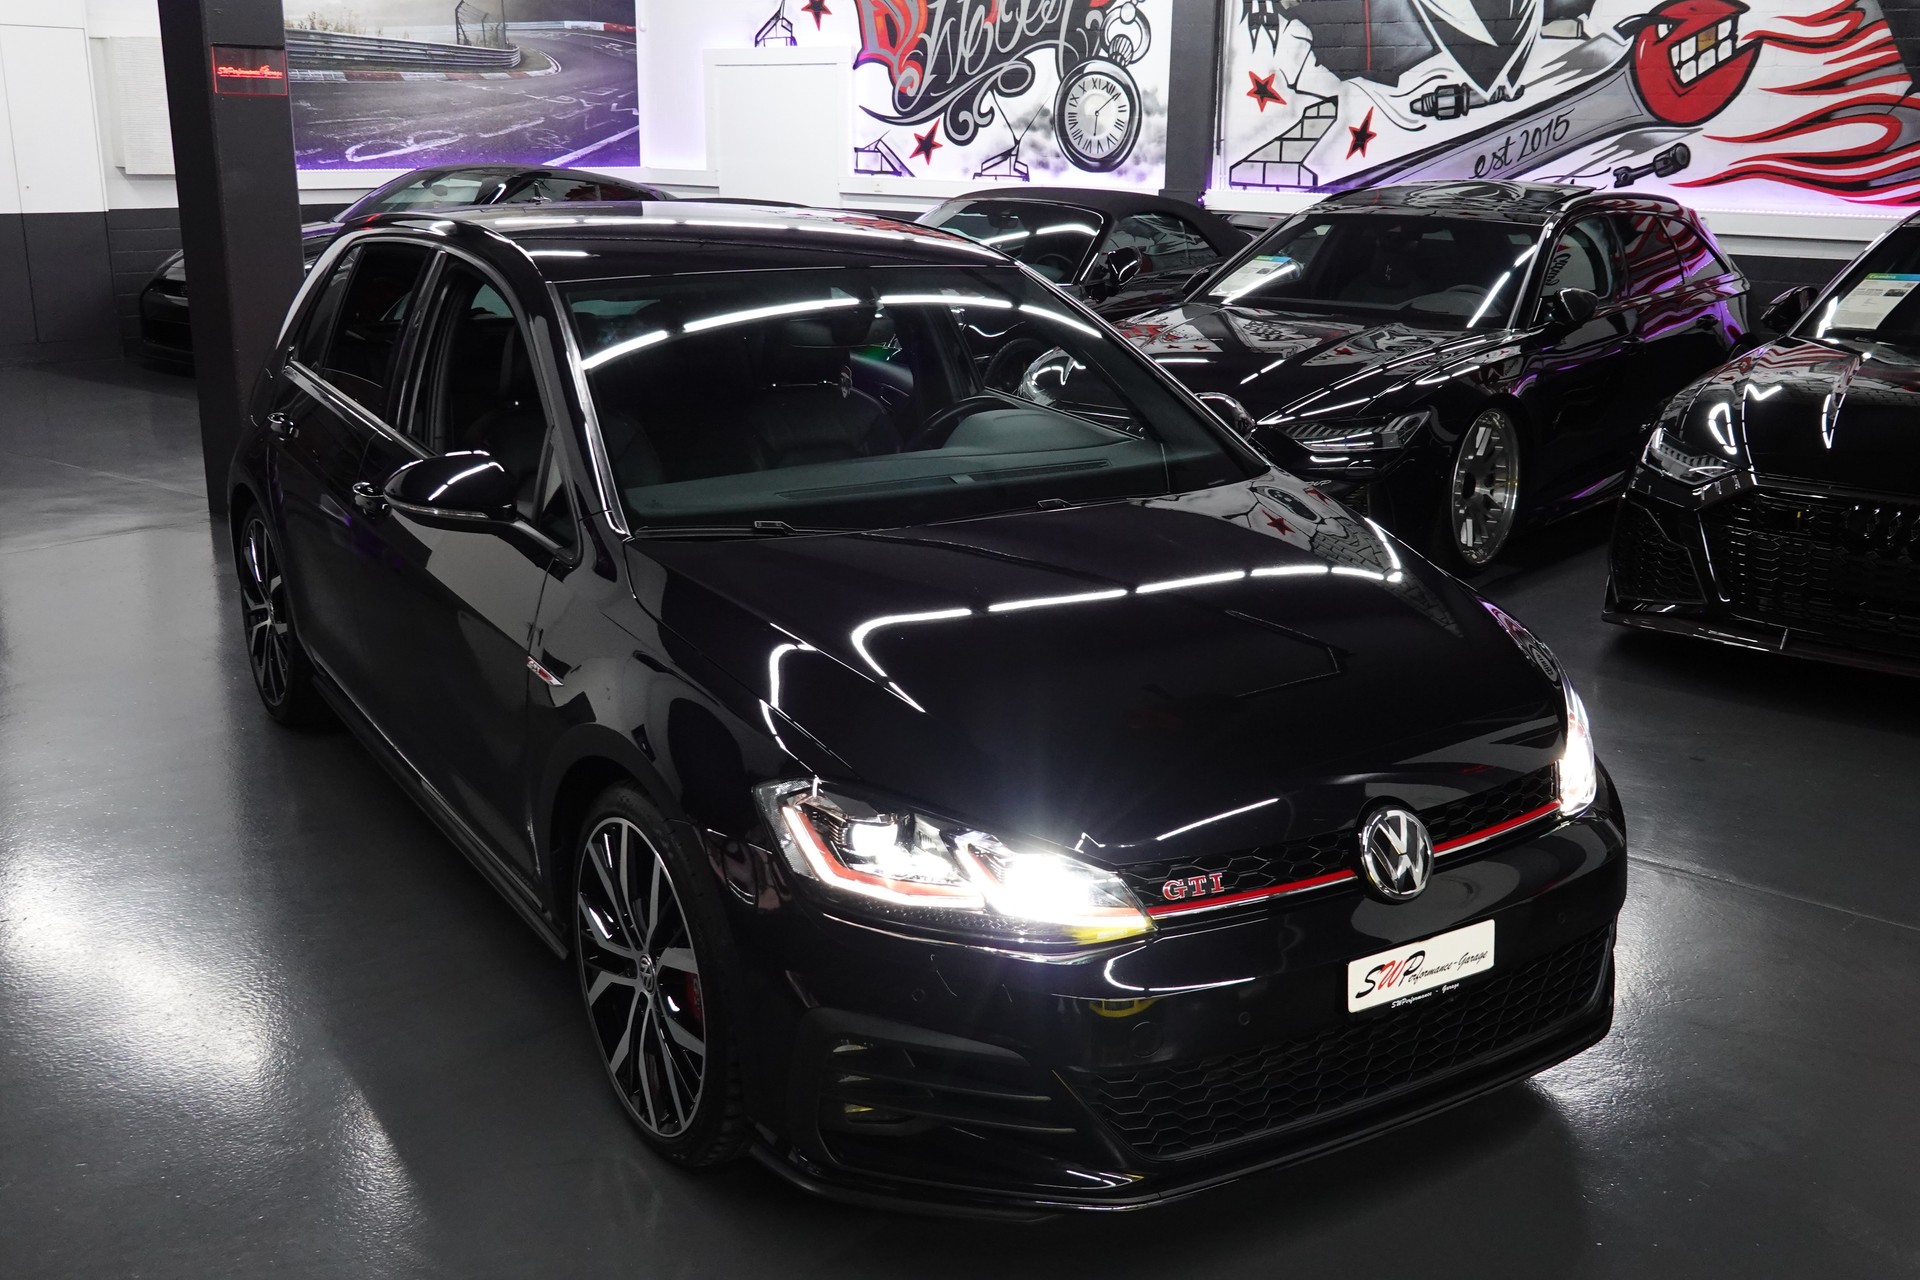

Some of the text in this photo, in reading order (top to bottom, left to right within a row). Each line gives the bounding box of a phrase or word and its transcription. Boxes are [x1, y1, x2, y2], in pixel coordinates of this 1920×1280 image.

[1468, 107, 1576, 179] est 2015
[1162, 872, 1225, 901] GTI
